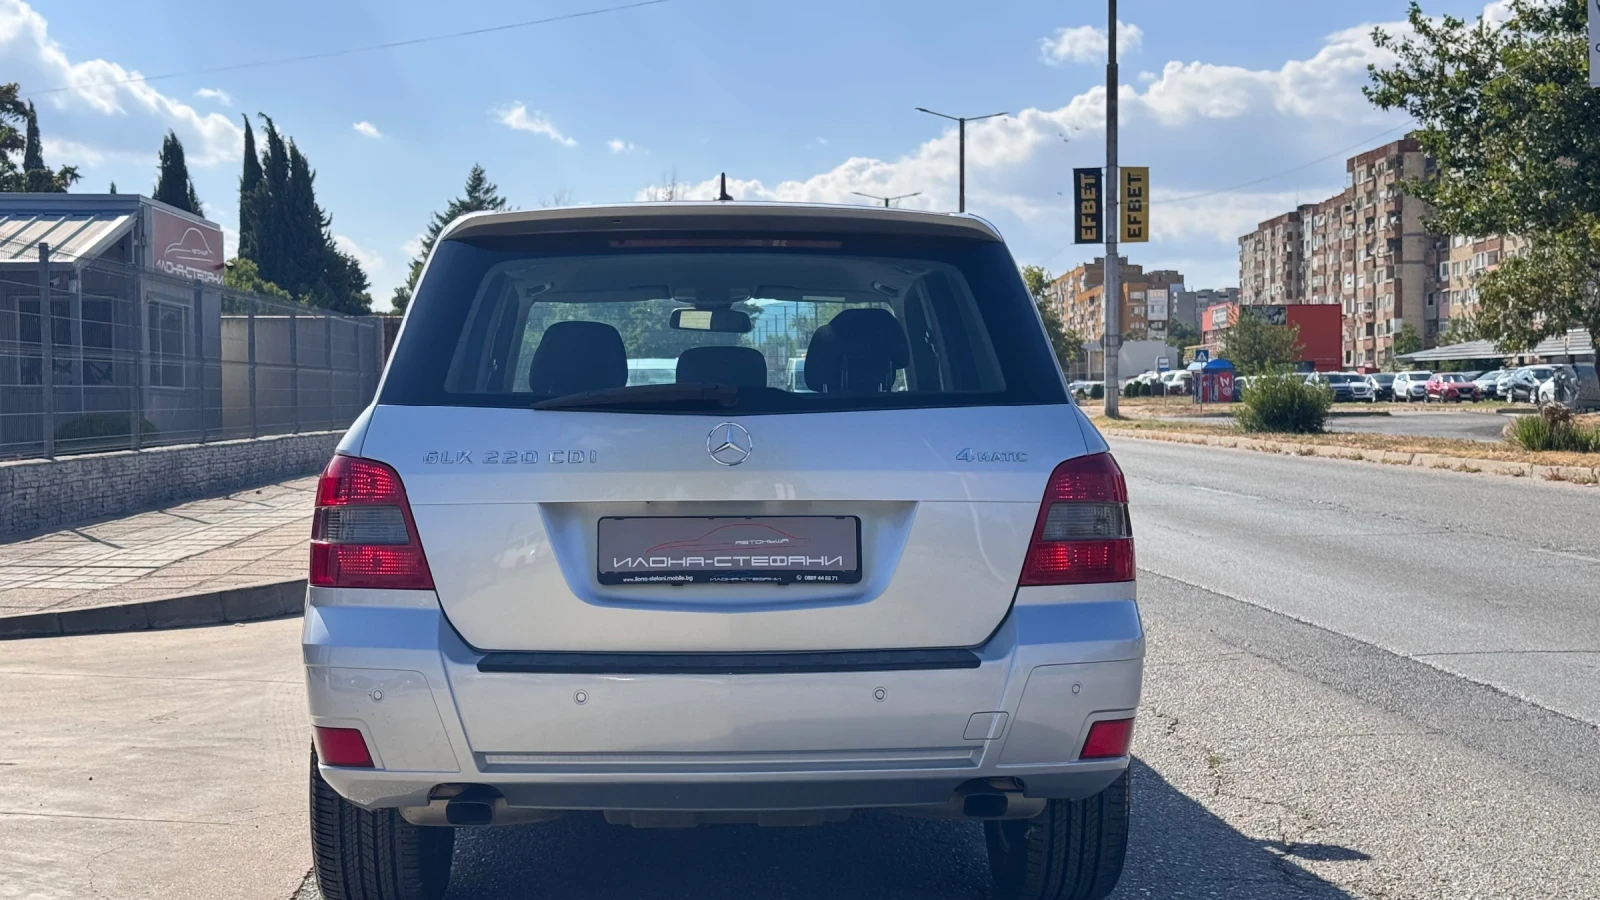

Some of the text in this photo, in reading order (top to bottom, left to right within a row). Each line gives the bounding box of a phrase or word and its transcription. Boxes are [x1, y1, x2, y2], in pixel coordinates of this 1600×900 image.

[1080, 173, 1096, 240] EFBET
[1127, 172, 1142, 238] EFBET
[422, 450, 598, 464] GLK 220 CDI
[613, 555, 843, 568] ИЛОНА-СТЕФАНИ
